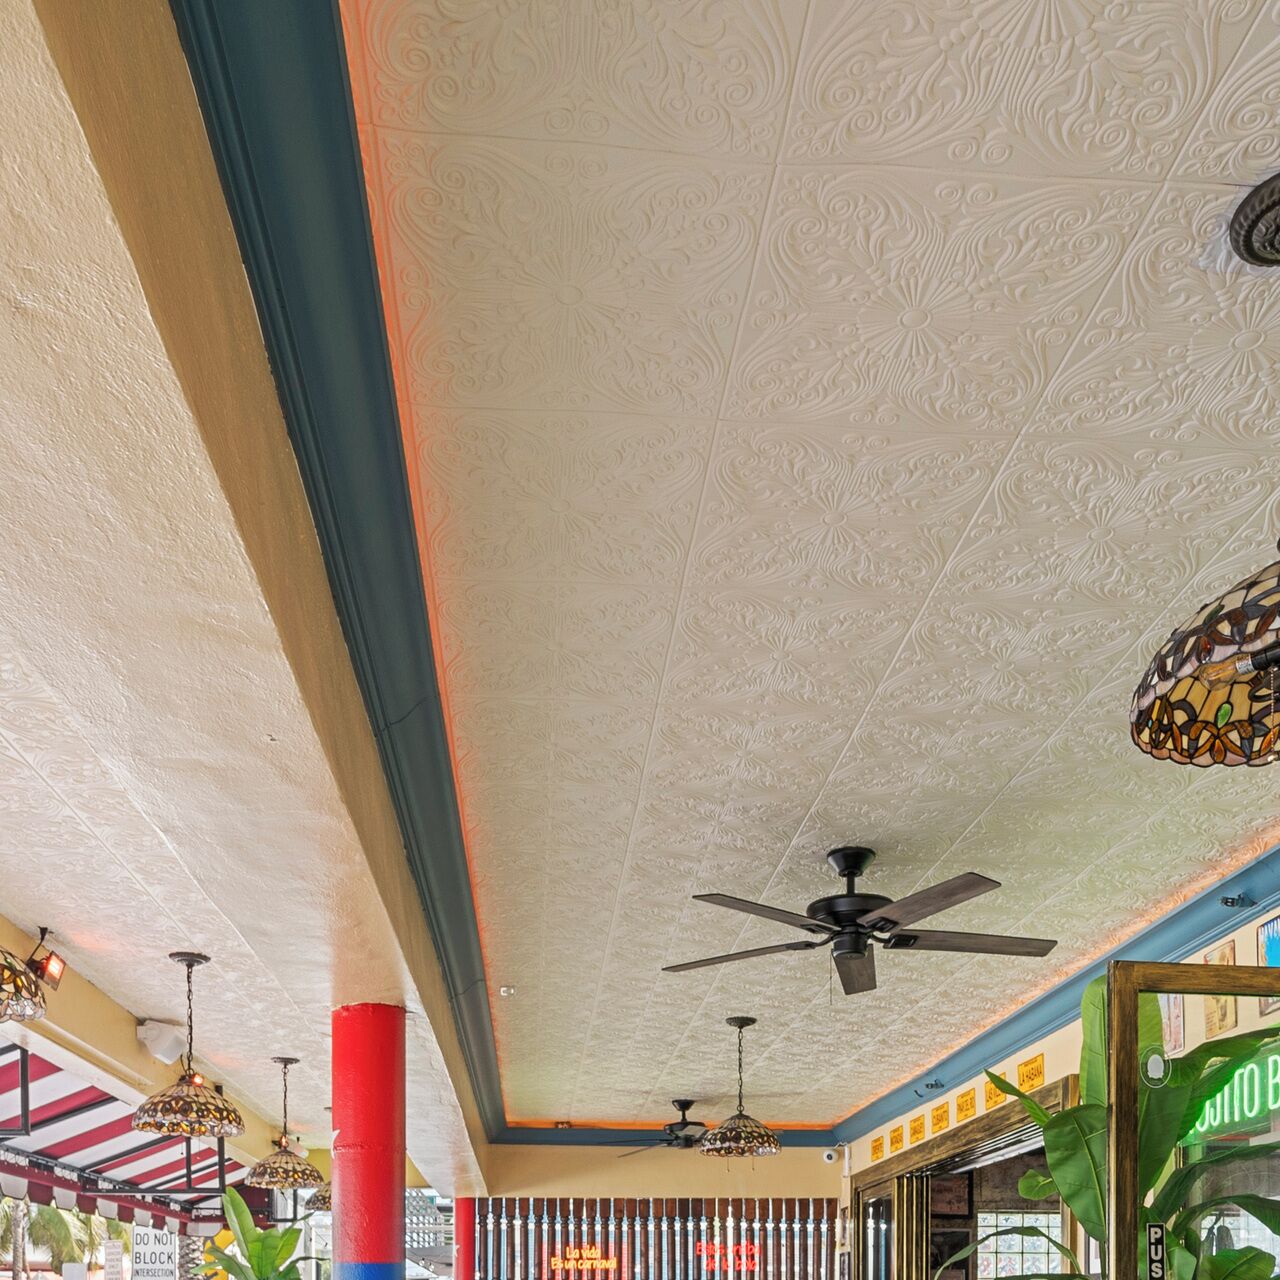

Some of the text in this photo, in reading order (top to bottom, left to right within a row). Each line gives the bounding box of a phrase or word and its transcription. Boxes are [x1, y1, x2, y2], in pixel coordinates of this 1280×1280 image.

[135, 1233, 173, 1246] DO NOT
[566, 1244, 601, 1259] La vida
[135, 1252, 174, 1265] BLOCK
[551, 1257, 617, 1270] Es un carnaval
[134, 1268, 174, 1277] INTERSECTION
